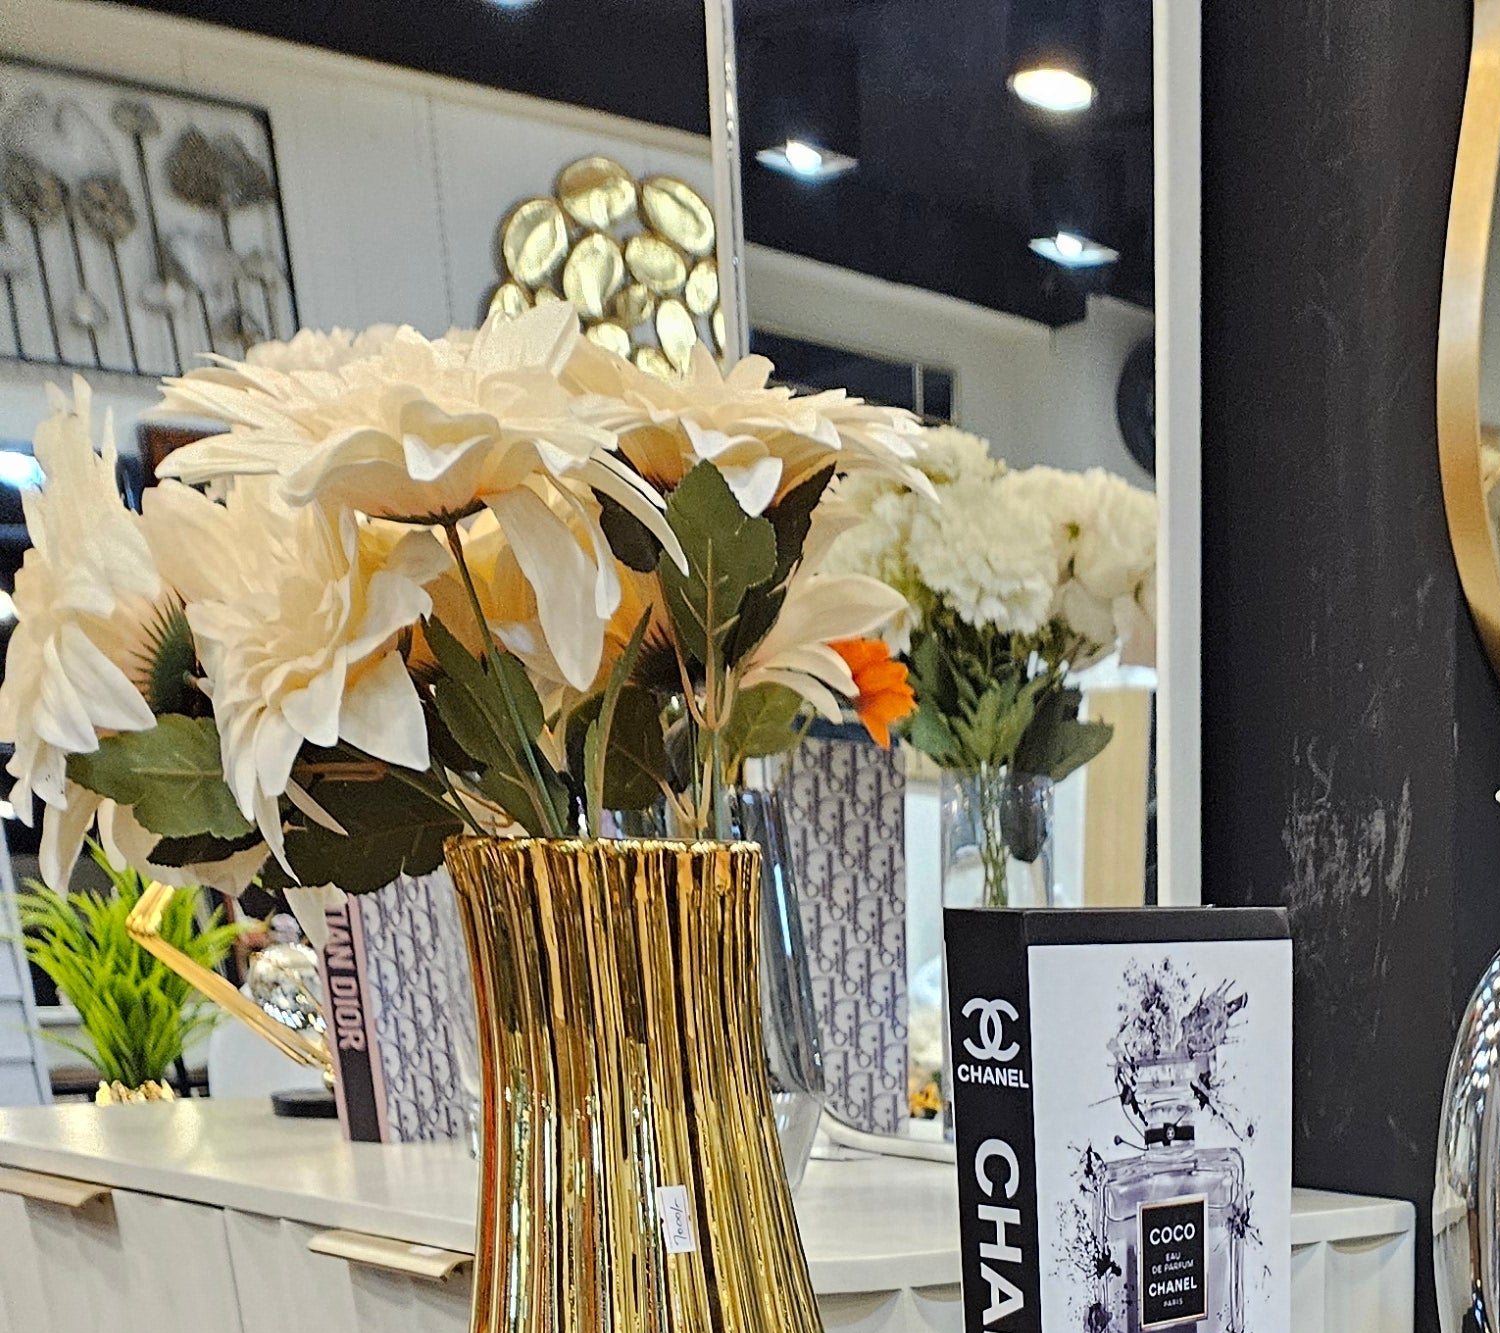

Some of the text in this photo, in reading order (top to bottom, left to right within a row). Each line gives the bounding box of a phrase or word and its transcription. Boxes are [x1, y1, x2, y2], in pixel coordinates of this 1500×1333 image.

[330, 975, 367, 1052] DIOR
[957, 1064, 1030, 1089] CHANEL
[1149, 1222, 1196, 1245] COCO
[1151, 1259, 1194, 1275] DE PARFUM
[1165, 1251, 1181, 1262] EAU
[1148, 1276, 1198, 1297] CHANEL
[1163, 1297, 1183, 1307] PARIS
